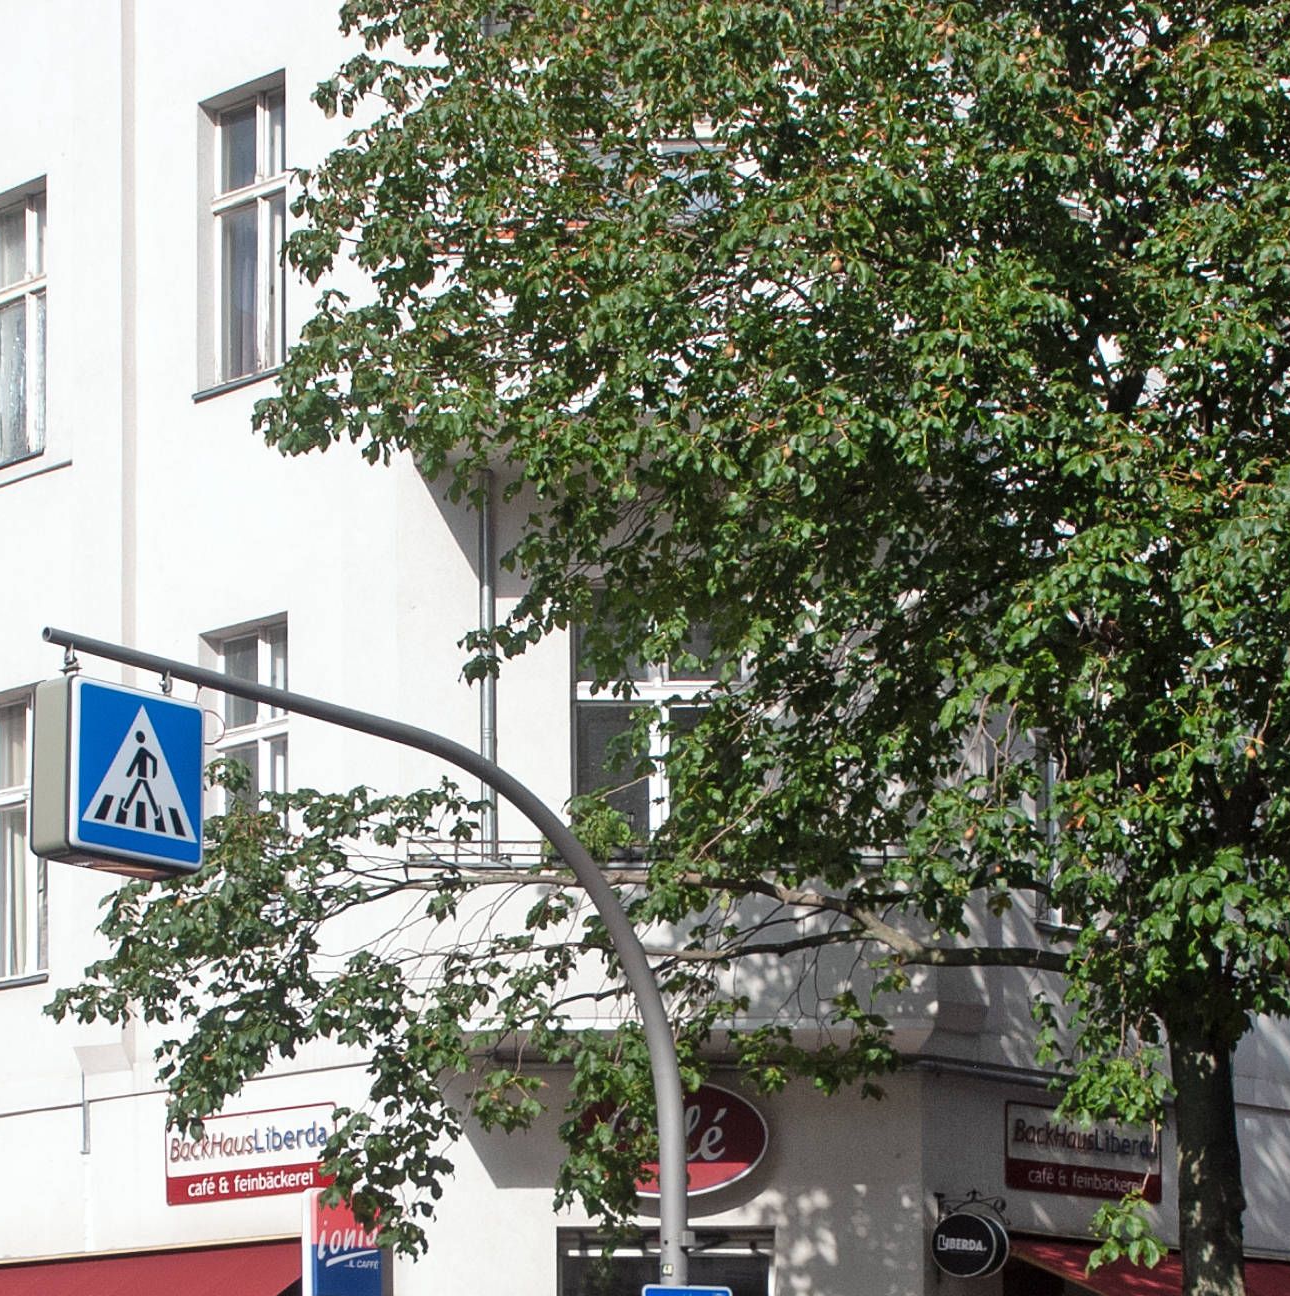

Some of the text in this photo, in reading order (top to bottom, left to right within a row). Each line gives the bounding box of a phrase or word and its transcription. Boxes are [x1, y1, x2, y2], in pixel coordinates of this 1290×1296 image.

[170, 1120, 329, 1163] BackHausLiberda
[188, 1168, 314, 1197] café & feinbäckerei
[1028, 1166, 1055, 1185] café
